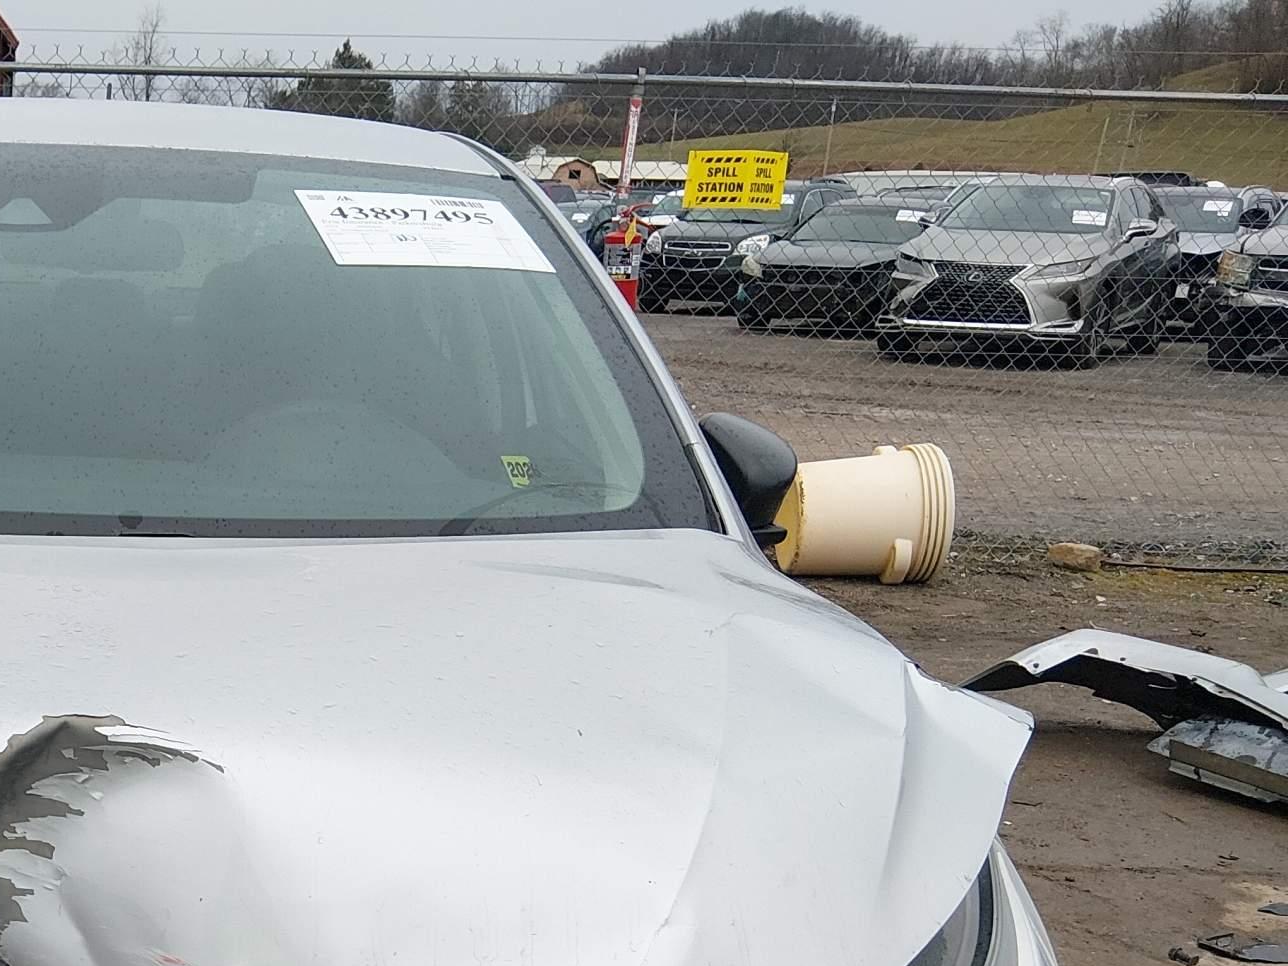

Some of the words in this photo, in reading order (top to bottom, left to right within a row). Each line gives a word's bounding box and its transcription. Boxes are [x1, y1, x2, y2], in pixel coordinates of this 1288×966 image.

[707, 167, 738, 177] SPILL
[756, 167, 772, 178] SPILL
[697, 182, 744, 192] STATION
[750, 182, 773, 193] STATION
[330, 206, 494, 225] 43897495
